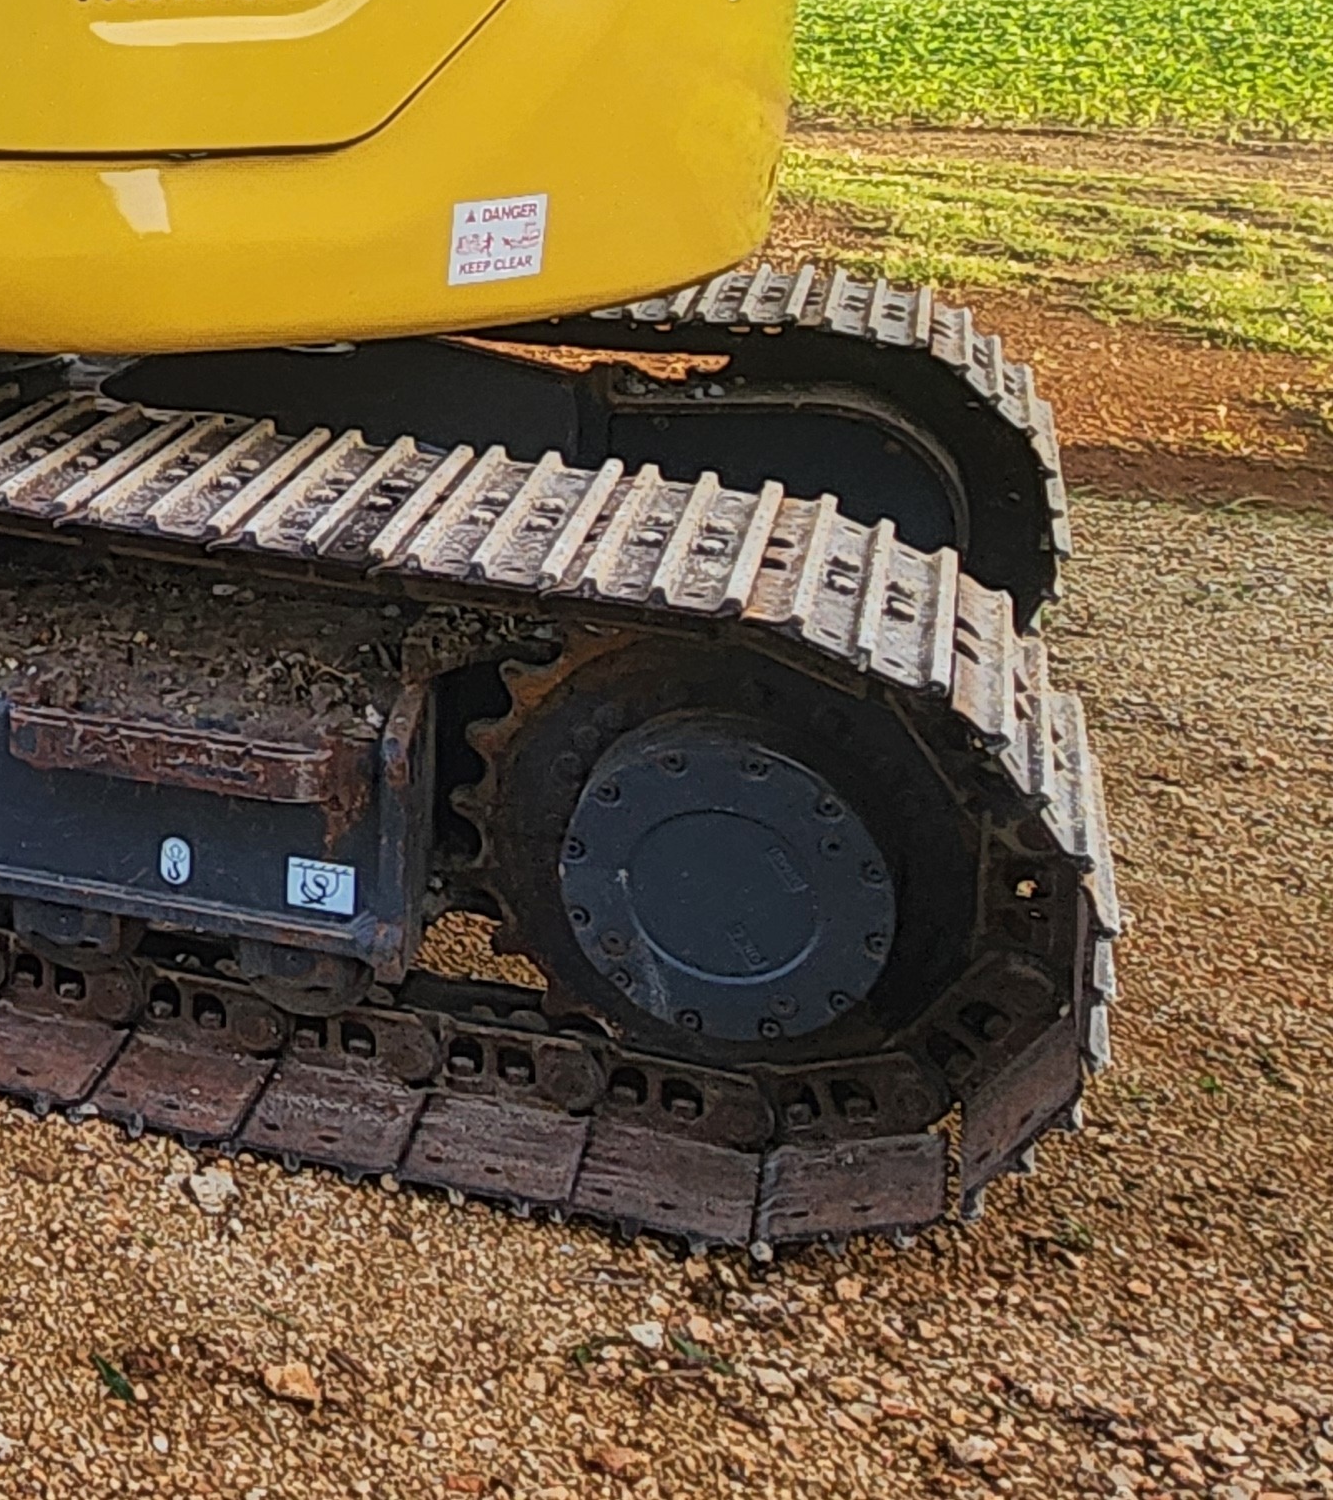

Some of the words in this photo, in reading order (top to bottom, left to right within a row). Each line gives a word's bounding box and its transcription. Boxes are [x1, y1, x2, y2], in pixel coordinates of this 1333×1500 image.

[481, 203, 538, 223] DANGER
[458, 260, 491, 275] KEEP
[493, 255, 533, 271] CLEAR
